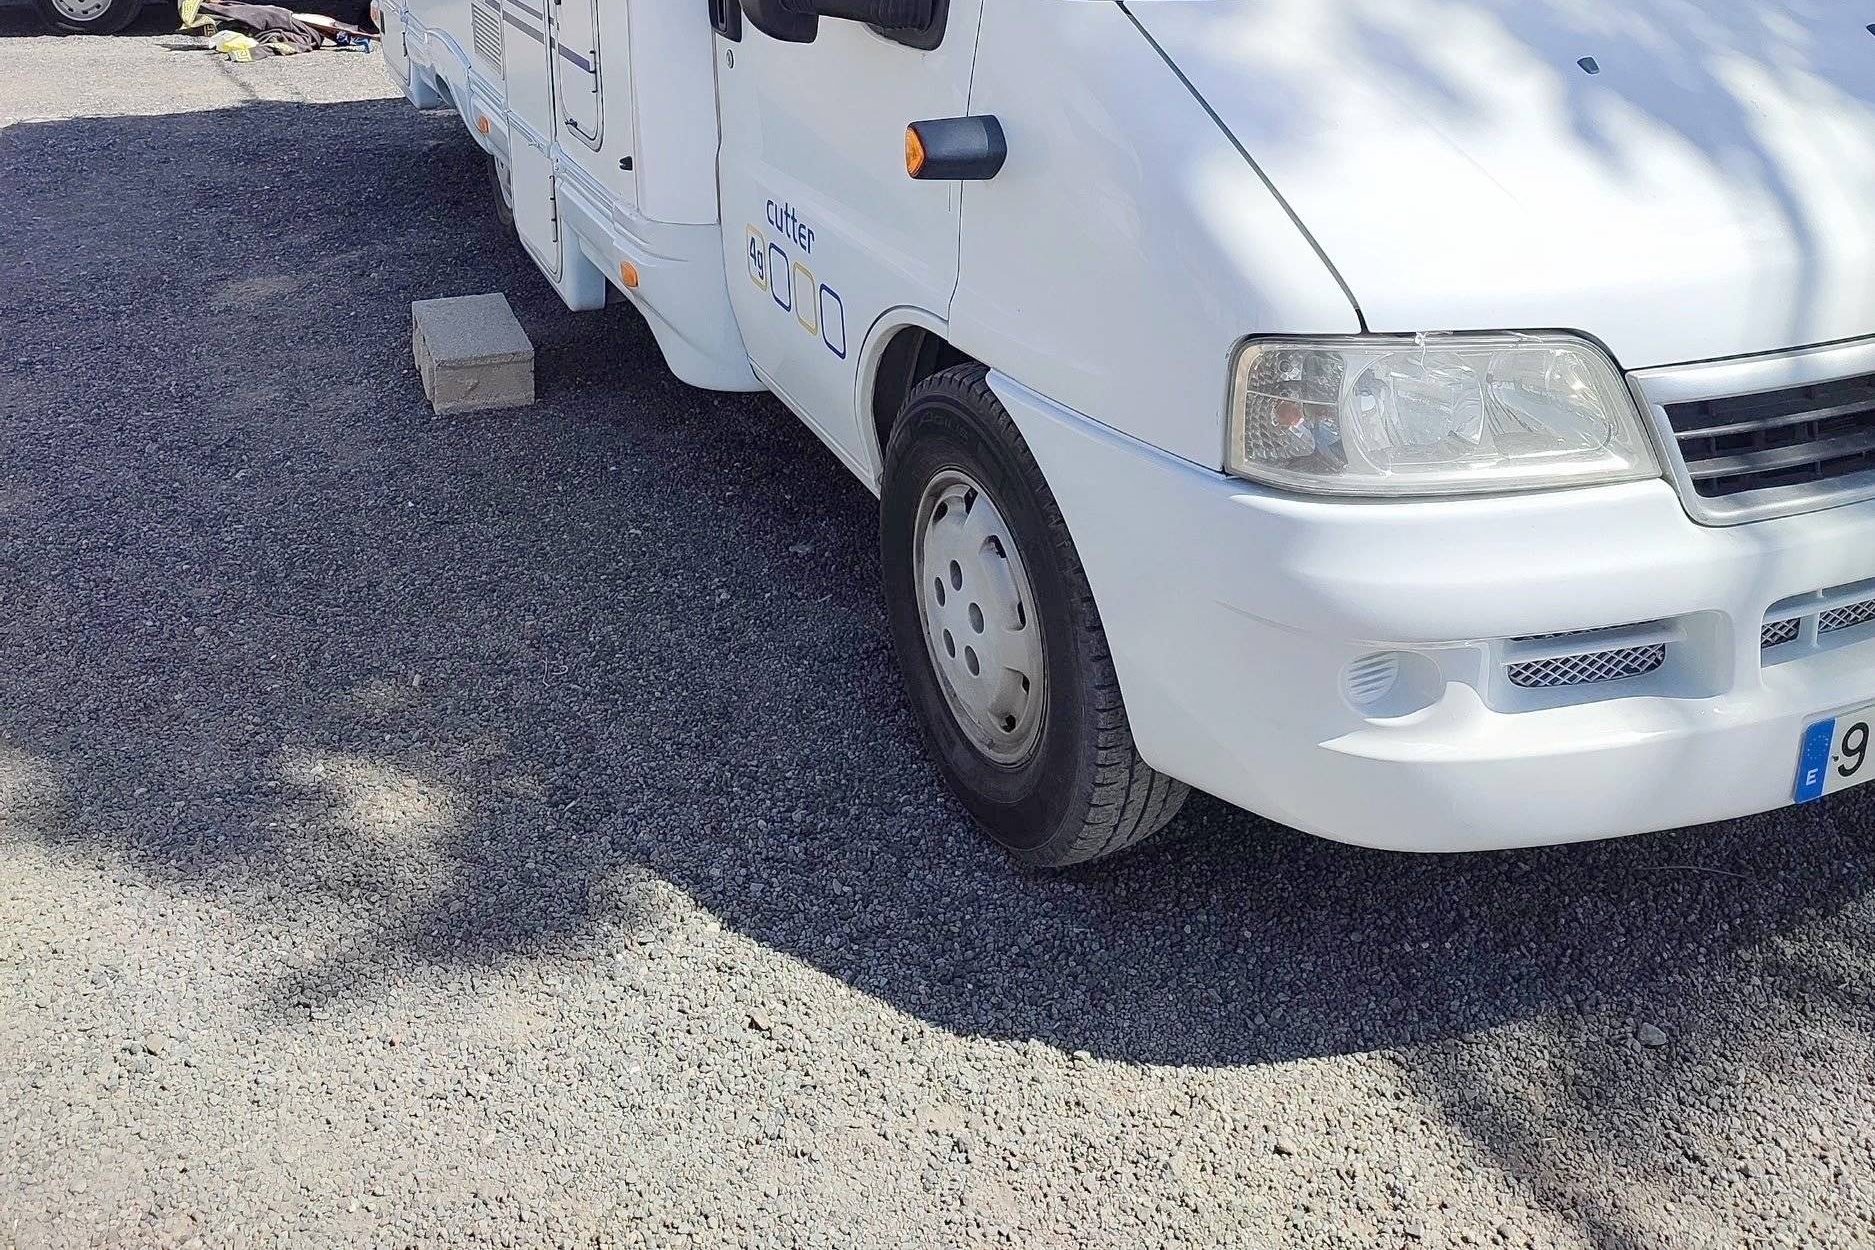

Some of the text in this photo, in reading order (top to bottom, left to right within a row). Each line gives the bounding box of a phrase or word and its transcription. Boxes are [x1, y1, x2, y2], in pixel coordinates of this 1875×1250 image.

[766, 199, 815, 255] cutter
[1805, 768, 1819, 786] E
[1837, 721, 1870, 778] 9
